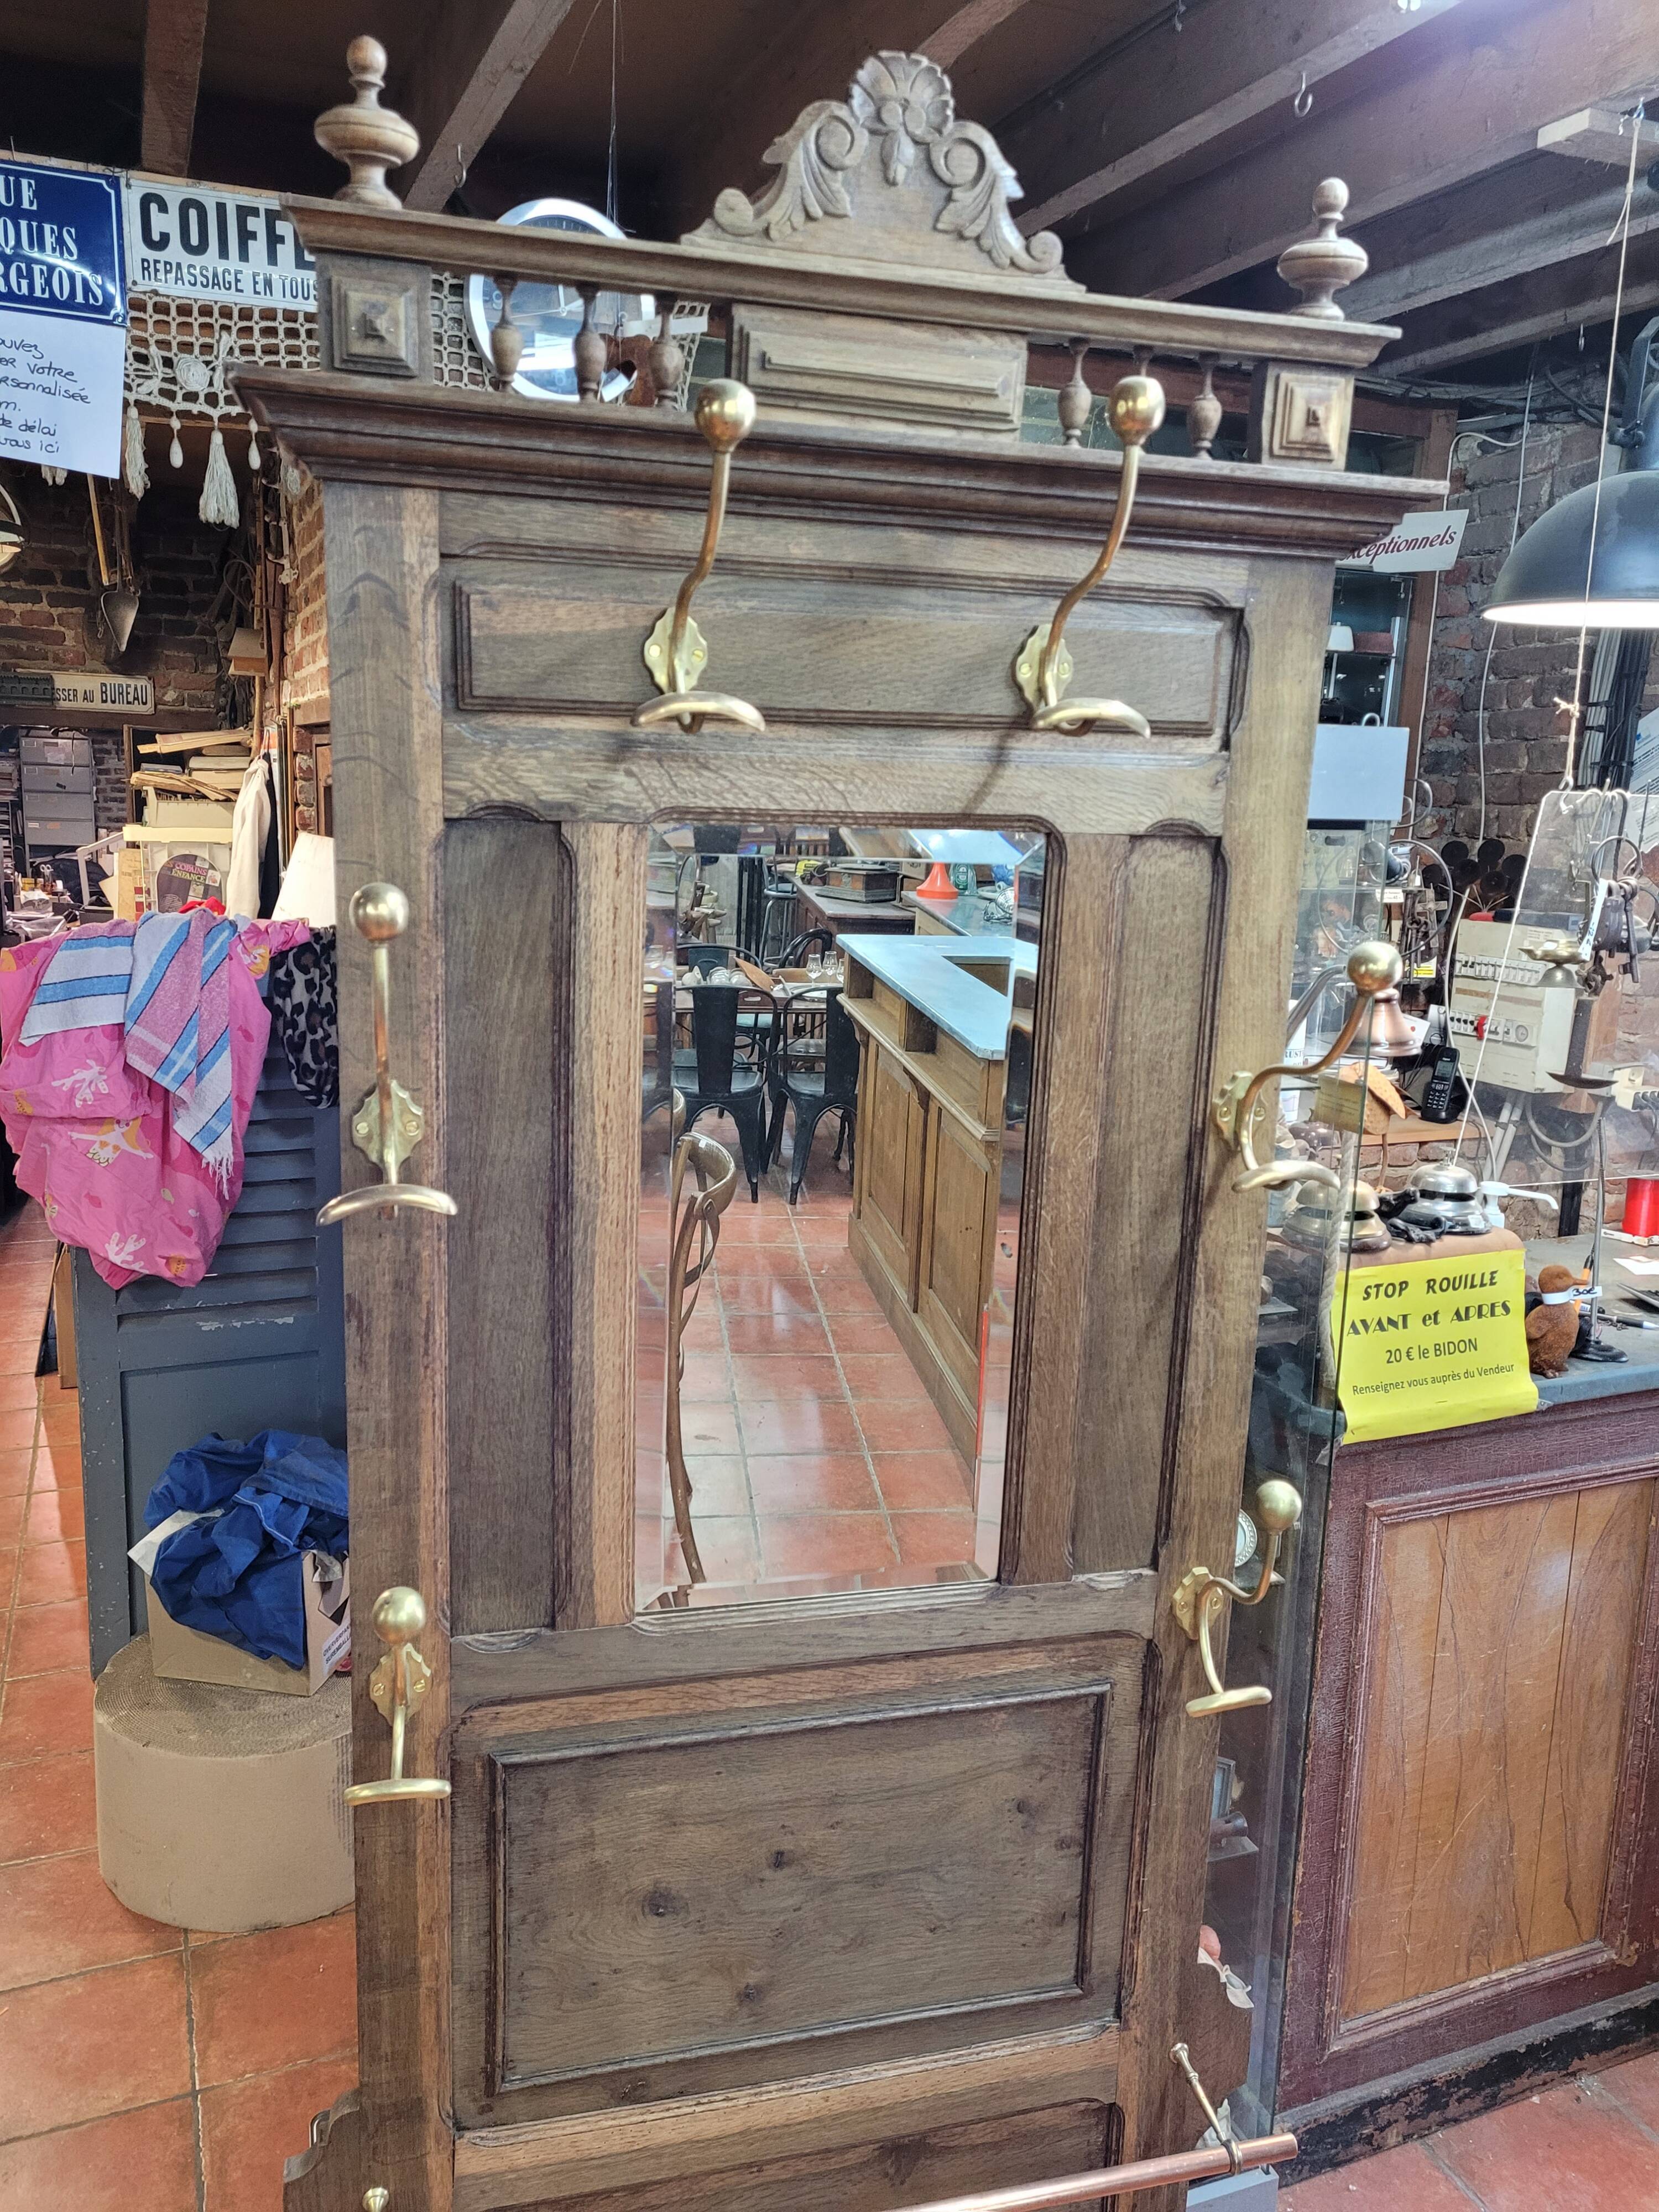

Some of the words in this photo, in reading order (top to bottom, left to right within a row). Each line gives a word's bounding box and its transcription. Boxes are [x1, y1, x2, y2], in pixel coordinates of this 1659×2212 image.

[0, 175, 37, 210] UE
[0, 216, 78, 260] QUES
[141, 258, 244, 293] REPASSAGE
[252, 271, 273, 296] EN
[1339, 525, 1457, 564] xceptionnels
[54, 687, 78, 703] SSER
[82, 689, 94, 703] AU
[100, 682, 148, 706] BUREAU
[175, 862, 207, 876] COPAINS
[1363, 1280, 1408, 1301] STOP
[1426, 1270, 1499, 1295] ROUILLE
[1347, 1313, 1411, 1337] AVANT
[1422, 1310, 1440, 1327] et
[1450, 1300, 1511, 1323] APRES
[1385, 1348, 1402, 1364] 20
[1406, 1347, 1415, 1360] €
[1418, 1344, 1430, 1359] le
[1433, 1338, 1478, 1357] BIDON
[1352, 1381, 1405, 1396] Renseignez
[1407, 1378, 1428, 1388] vous
[1431, 1369, 1462, 1385] auprès
[1463, 1369, 1475, 1379] du
[1477, 1363, 1515, 1378] Vendeur
